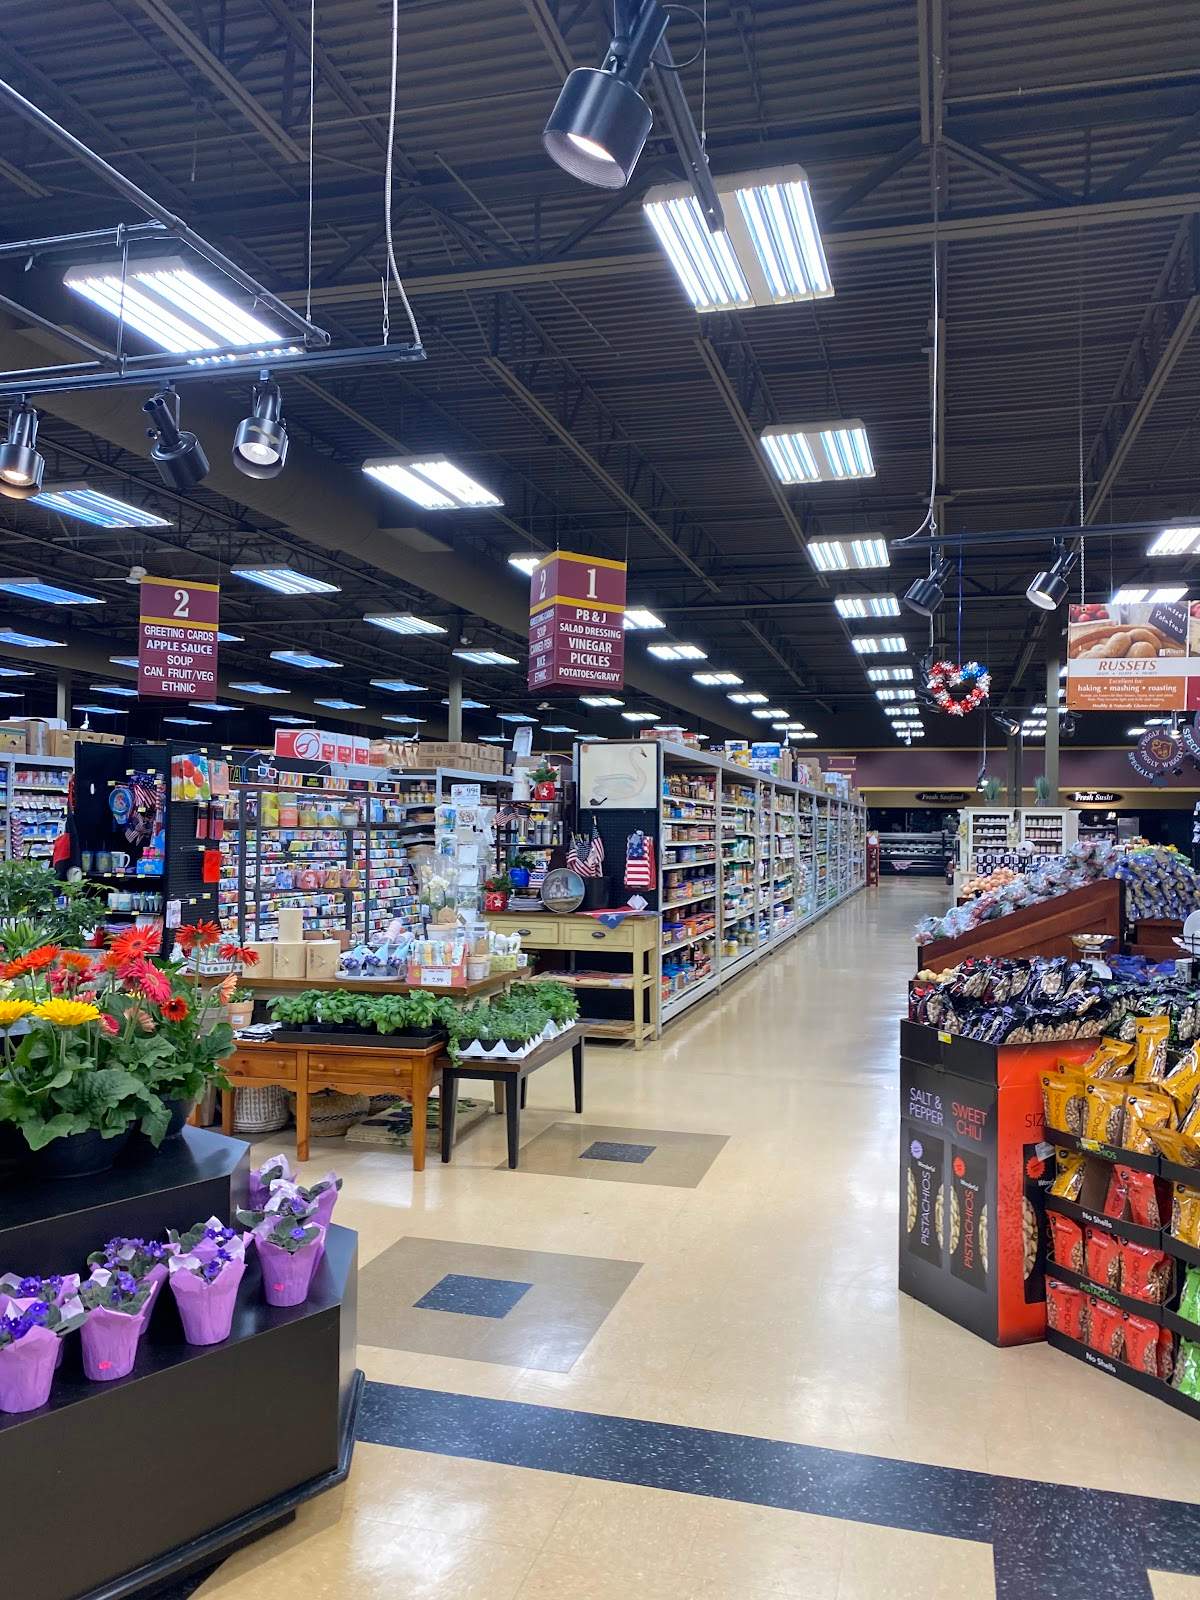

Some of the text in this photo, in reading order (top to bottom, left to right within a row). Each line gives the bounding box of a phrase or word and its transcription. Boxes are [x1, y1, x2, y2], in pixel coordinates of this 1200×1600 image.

[539, 569, 547, 600] 2
[586, 568, 598, 599] 1
[173, 589, 190, 618] 2
[576, 608, 607, 624] PB & J
[144, 625, 214, 642] GREETING CARDS
[560, 622, 621, 639] SALAD DRESSING
[146, 639, 213, 655] APPLE SAUCE
[568, 637, 613, 653] VINEGAR
[167, 655, 194, 666] SOUP
[570, 652, 610, 667] PICKLES
[1098, 660, 1157, 671] RUSSETS
[144, 666, 214, 682] CAN. FRUIT/VEG
[559, 667, 620, 682] POTATOES/GRAVY
[161, 681, 197, 693] ETHNIC
[1077, 684, 1177, 693] baking mashing roasting
[1127, 751, 1154, 779] SPECIALS
[1140, 750, 1184, 768] PIGGLY WIGGLY
[1075, 791, 1114, 801] Fresh Sushi
[909, 1087, 942, 1110] SALT &
[909, 1102, 944, 1127] PEPPER
[951, 1102, 988, 1126] SWEET
[956, 1122, 982, 1142] CHILI
[920, 1170, 931, 1246] PISTACHIOS
[1082, 1211, 1113, 1229] No Shells
[963, 1189, 975, 1269] PISTACHIOS
[1085, 1352, 1117, 1373] No Shells
